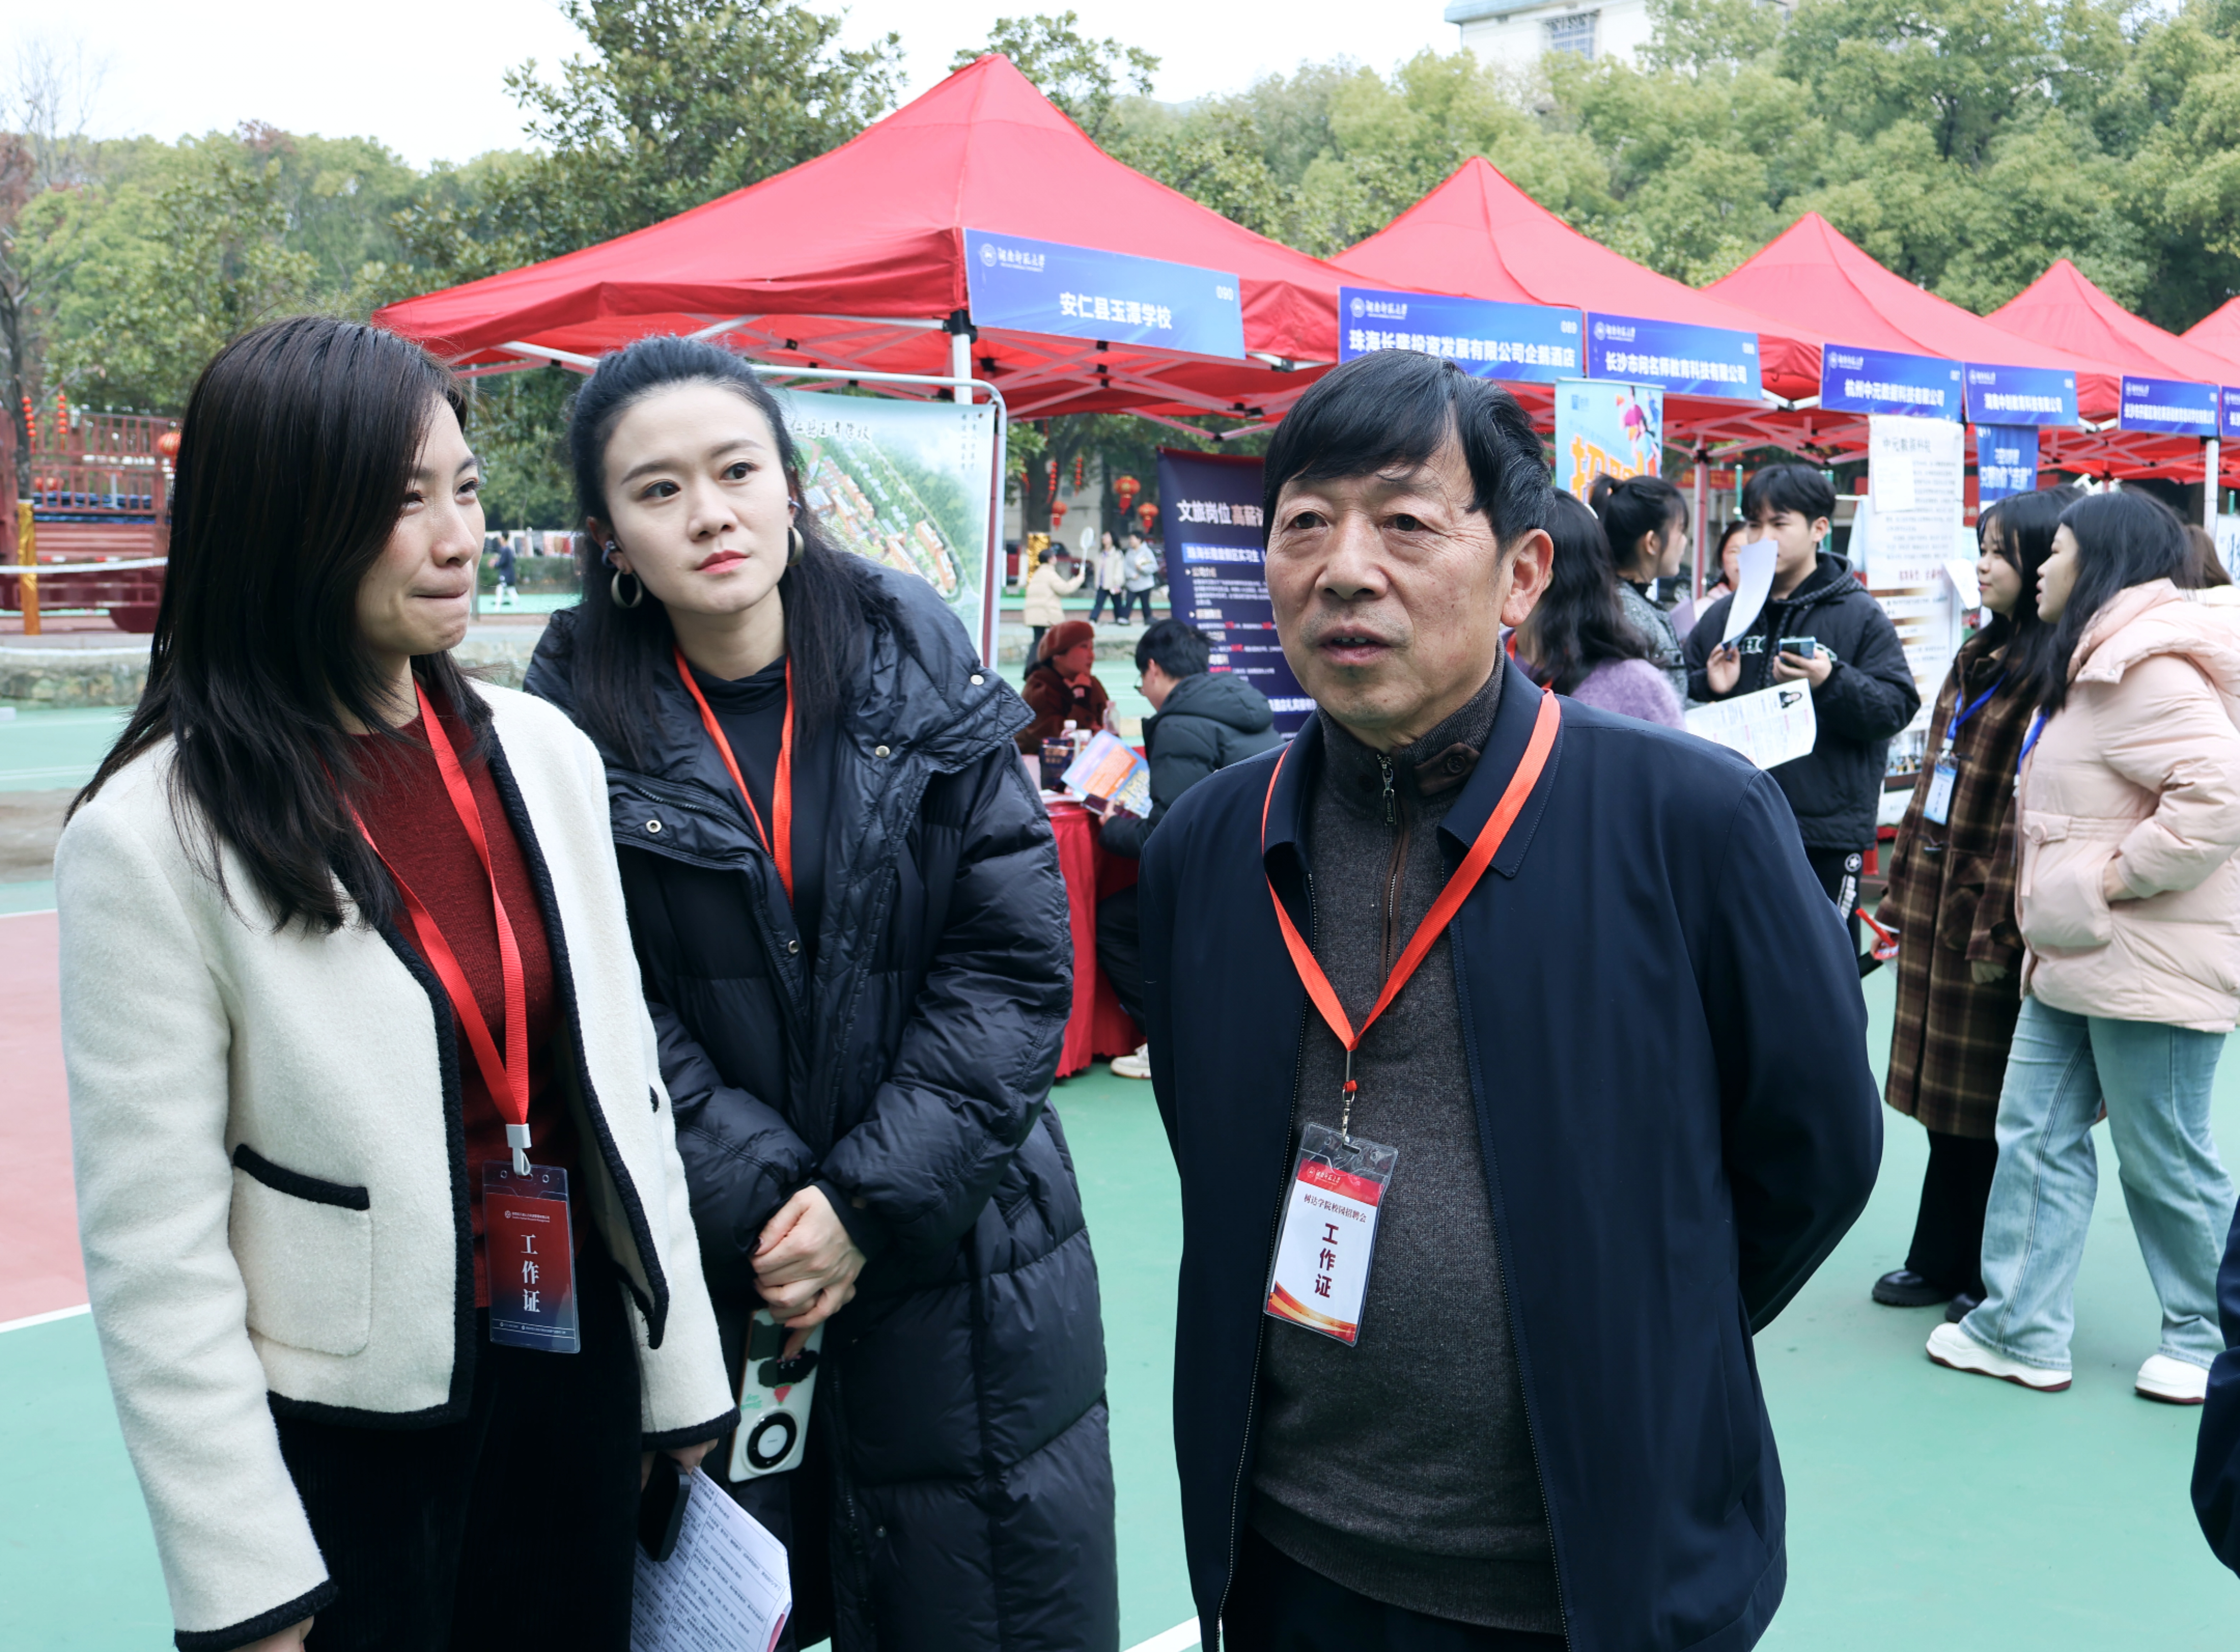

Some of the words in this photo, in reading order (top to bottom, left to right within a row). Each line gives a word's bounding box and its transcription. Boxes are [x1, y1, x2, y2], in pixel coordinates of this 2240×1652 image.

[1059, 292, 1172, 330] 安仁县玉潭学校
[1216, 285, 1234, 301] 090
[1304, 1193, 1367, 1223] 树达学院校园招聘会
[520, 1234, 540, 1312] 工作证
[1315, 1223, 1339, 1298] 工作证
